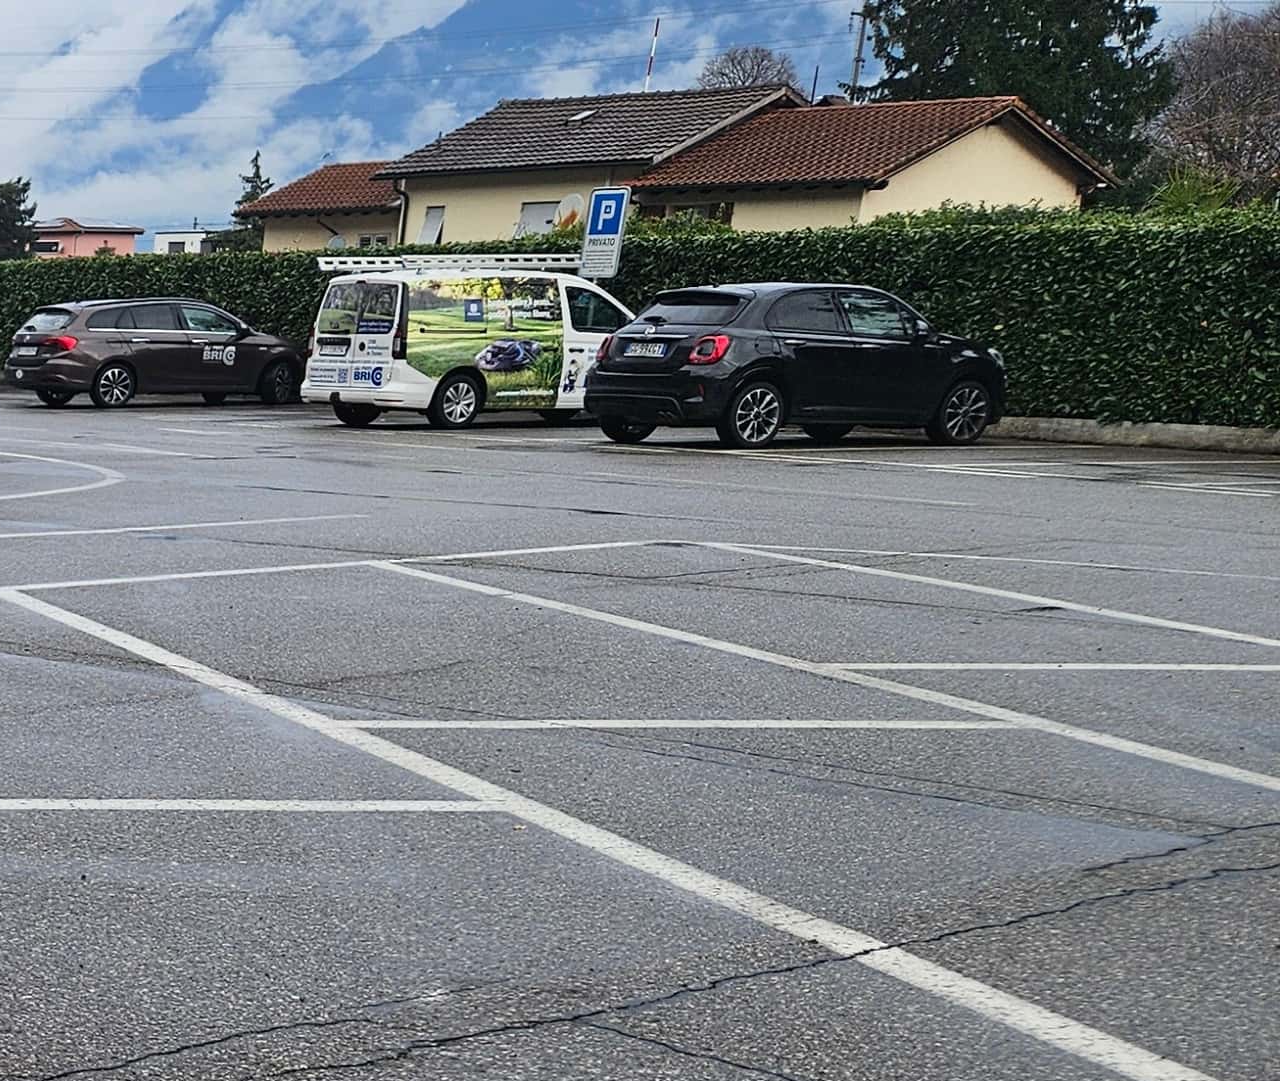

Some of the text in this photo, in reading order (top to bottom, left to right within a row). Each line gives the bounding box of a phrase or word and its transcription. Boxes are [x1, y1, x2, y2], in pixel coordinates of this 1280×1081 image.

[597, 200, 616, 231] P
[587, 238, 616, 247] PRIVATO
[353, 366, 383, 386] BRICO
